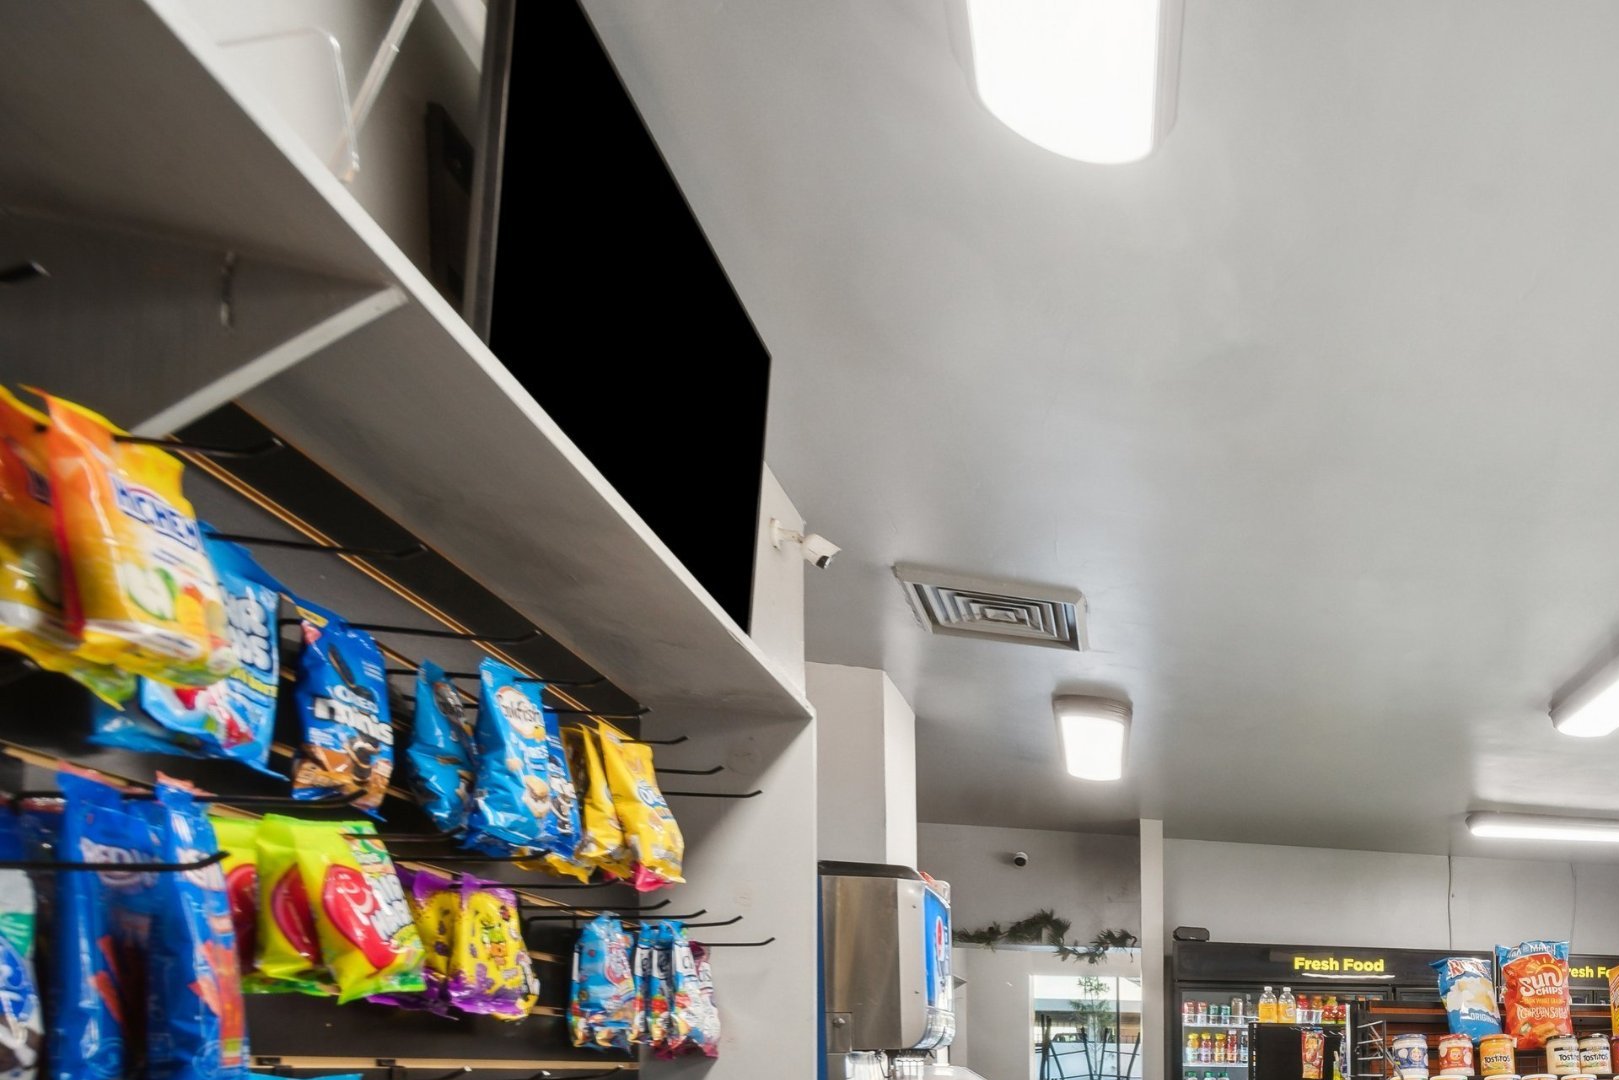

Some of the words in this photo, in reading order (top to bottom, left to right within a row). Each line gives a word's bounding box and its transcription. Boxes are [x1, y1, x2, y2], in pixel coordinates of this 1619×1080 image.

[1294, 957, 1340, 971] Fresh
[1343, 958, 1385, 972] Food
[1568, 966, 1594, 979] resh
[1519, 971, 1563, 997] Sun
[1536, 987, 1563, 995] CHIPS
